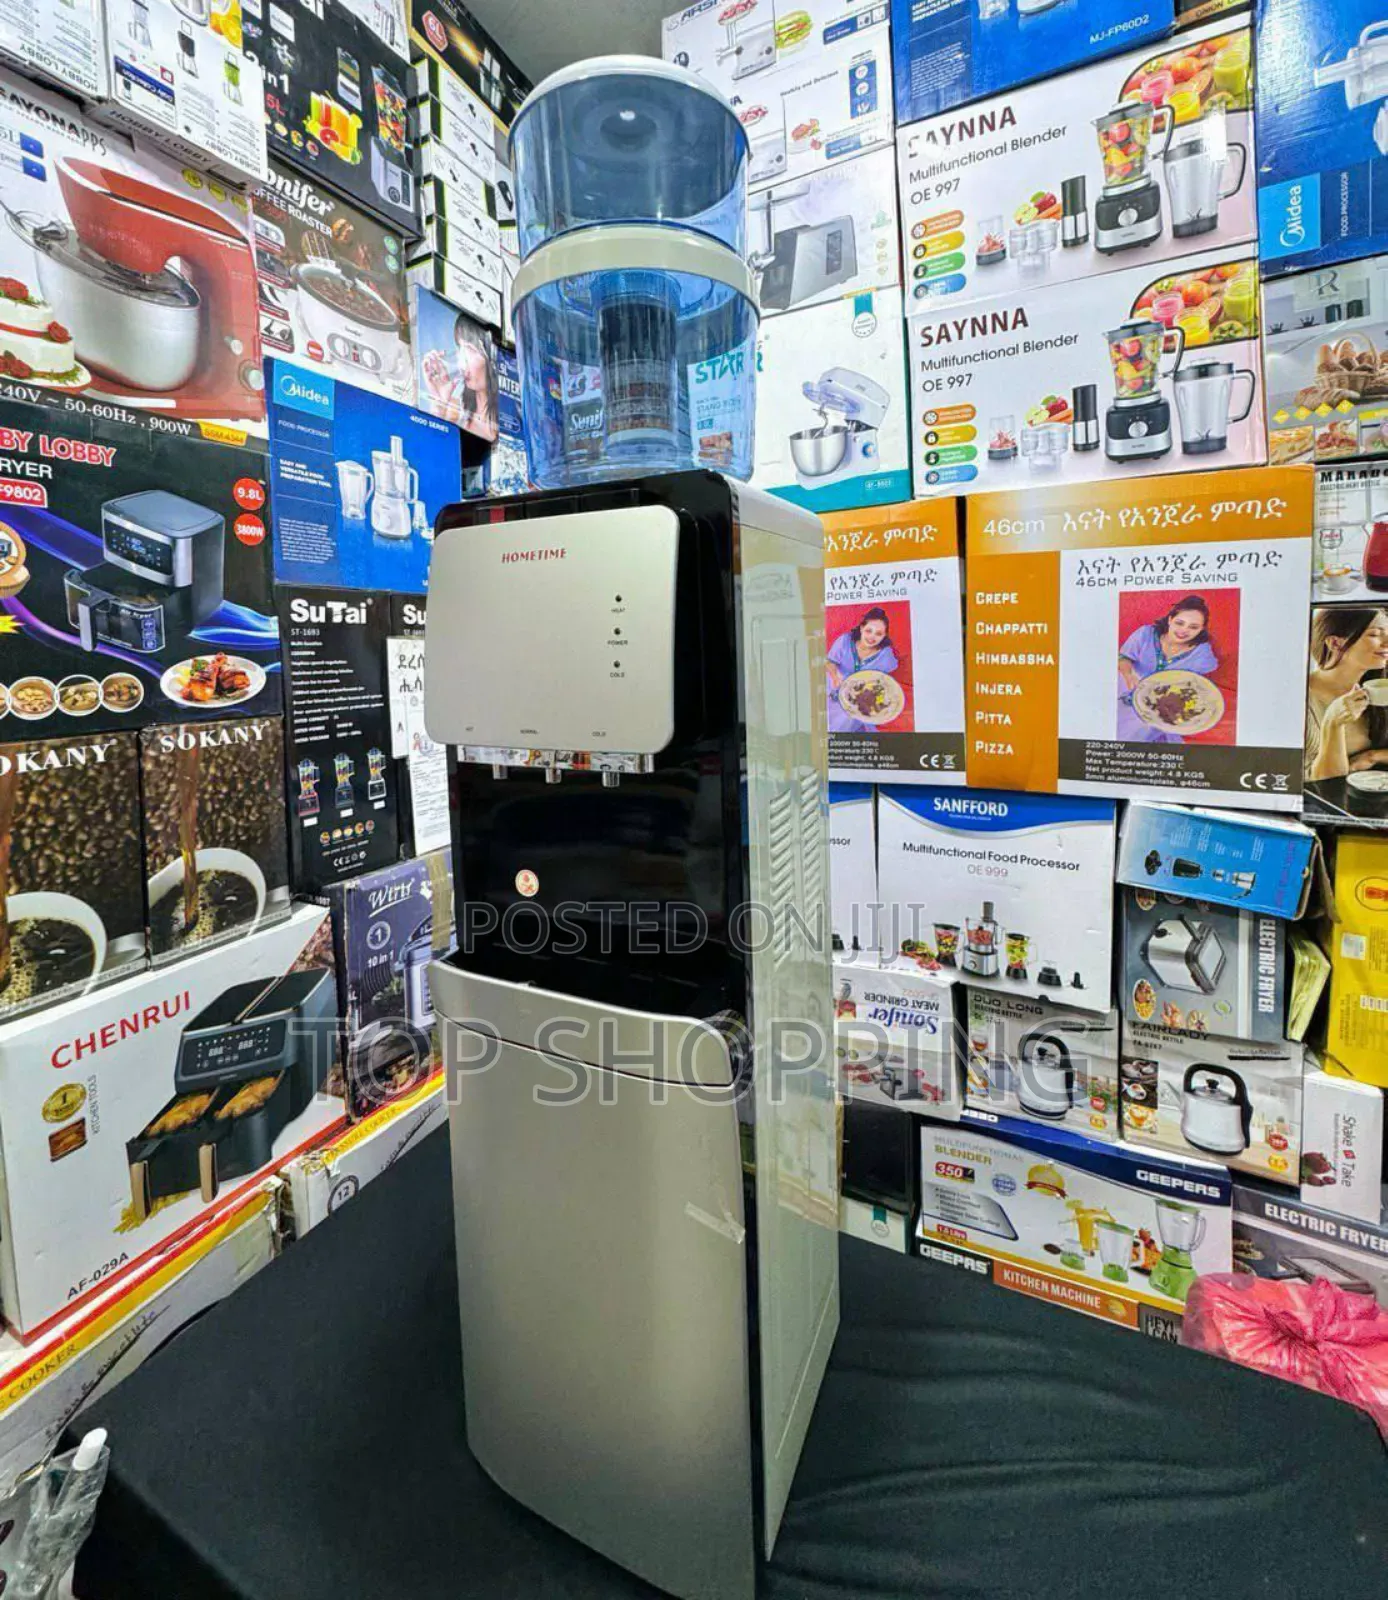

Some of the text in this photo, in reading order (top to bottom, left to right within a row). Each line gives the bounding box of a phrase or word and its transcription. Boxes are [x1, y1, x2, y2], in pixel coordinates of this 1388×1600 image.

[109, 109, 213, 165] HOBBY LOBBY
[908, 124, 1068, 184] Multifunctional Blender
[909, 177, 962, 206] OE 997
[1283, 185, 1303, 240] Midea
[920, 307, 1029, 347] SAYNNA
[920, 333, 1079, 372] Multifunctional Blender
[283, 377, 330, 406] Midea
[922, 373, 973, 392] OE 997
[65, 399, 137, 424] 50-60Hz
[149, 416, 193, 435] 900W
[40, 433, 117, 467] LOBBY
[983, 518, 1046, 536] 46cm
[501, 547, 567, 564] HOMETIME
[290, 598, 367, 625] SuTai
[933, 796, 1008, 818] SANFFORD
[902, 841, 1080, 873] Multifunctional Food Processor
[967, 864, 1009, 878] OE 999
[1256, 918, 1276, 1014] ELECTRIC FRYER
[863, 991, 909, 1008] GRINDER
[910, 1000, 940, 1012] MEAT
[1007, 1001, 1043, 1015] LONG
[51, 991, 190, 1069] CHENRUI
[868, 1006, 940, 1035] Sonifer
[936, 1162, 964, 1178] 350
[1341, 1162, 1356, 1188] Take
[337, 1185, 351, 1201] 12
[1264, 1202, 1337, 1237] ELECTRIC
[67, 1252, 129, 1300] AF-029A
[1003, 1267, 1101, 1309] KITCHEN MACHINE
[9, 1344, 77, 1399] COOKER
